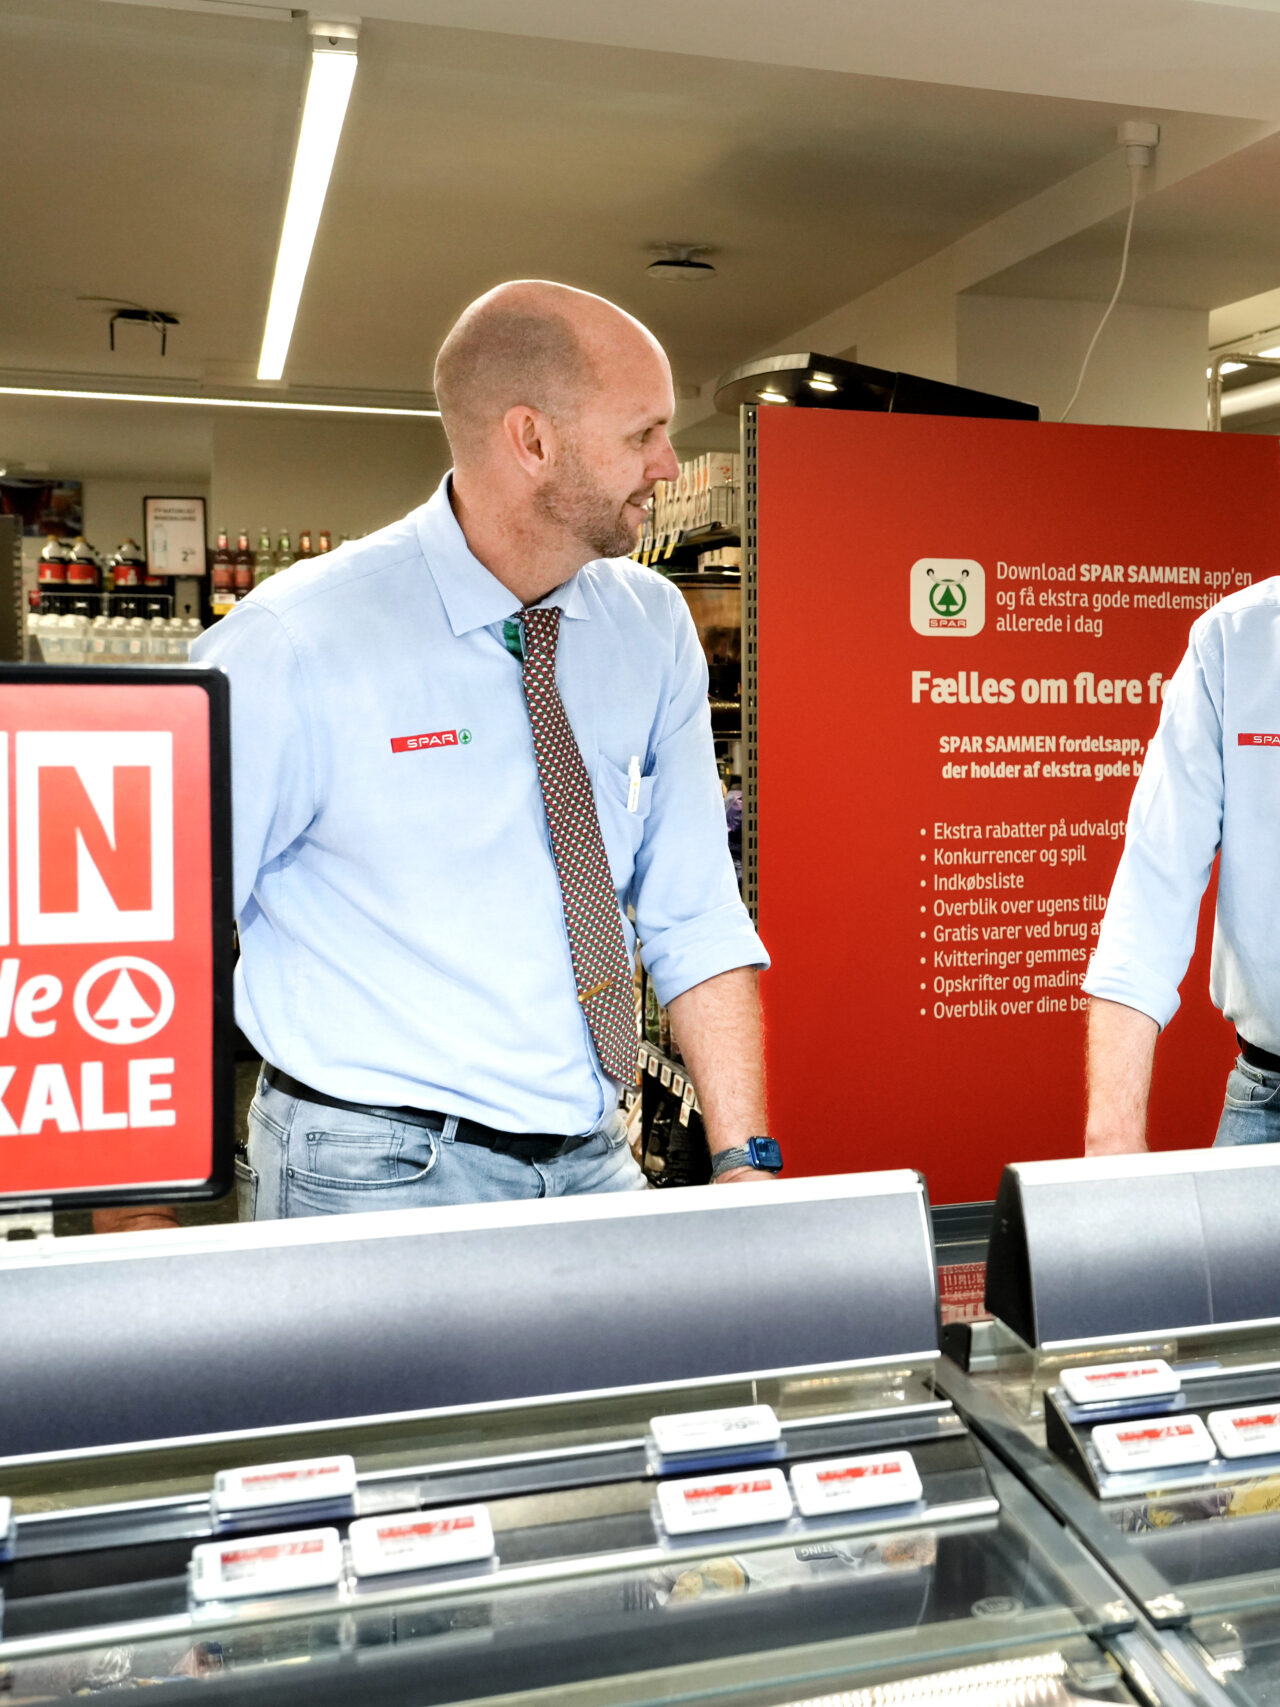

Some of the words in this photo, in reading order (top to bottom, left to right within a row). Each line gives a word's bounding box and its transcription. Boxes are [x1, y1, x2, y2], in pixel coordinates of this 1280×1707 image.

[996, 561, 1077, 582] Download
[1080, 563, 1125, 583] SPAR
[1128, 565, 1201, 585] SAMMEN
[1204, 568, 1253, 590] app'en
[996, 591, 1016, 610] og
[1019, 587, 1035, 607] få
[1039, 589, 1089, 607] ekstra
[1092, 590, 1130, 610] gode
[1133, 592, 1224, 610] medlemstil
[930, 619, 967, 628] SPAR
[996, 613, 1063, 632] allerede
[1066, 615, 1071, 632] i
[1074, 615, 1103, 637] dag
[911, 670, 1016, 704] Fælles
[1021, 677, 1068, 704] om
[1074, 671, 1143, 704] flere
[407, 732, 455, 750] SPAR
[939, 735, 983, 753] SPAR
[986, 735, 1057, 754] SAMMEN
[1059, 736, 1145, 757] fordelsapp,
[942, 761, 968, 779] der
[971, 761, 1020, 779] holder
[1023, 761, 1040, 779] af
[1042, 761, 1092, 779] ekstra
[1094, 760, 1131, 782] gode
[933, 821, 983, 840] Ekstra
[985, 820, 1047, 840] rabatter
[1049, 817, 1068, 841] på
[1070, 818, 1128, 841] udvalgt
[933, 848, 1037, 866] Konkurrencer
[1039, 849, 1058, 867] og
[1060, 845, 1087, 867] spil
[933, 872, 1025, 891] Indkøbsliste
[933, 897, 998, 917] Overblik
[1000, 898, 1035, 915] over
[1036, 897, 1080, 917] ugens
[933, 923, 979, 943] Gratis
[982, 924, 1022, 941] varer
[1025, 922, 1051, 939] ved
[1053, 920, 1088, 941] brug
[933, 946, 1023, 969] Kvitteringer
[1026, 946, 1087, 967] gemmes
[933, 972, 1010, 996] Opskrifter
[1012, 974, 1031, 994] og
[933, 998, 998, 1019] Overblik
[1000, 998, 1034, 1017] over
[1036, 996, 1067, 1014] dine
